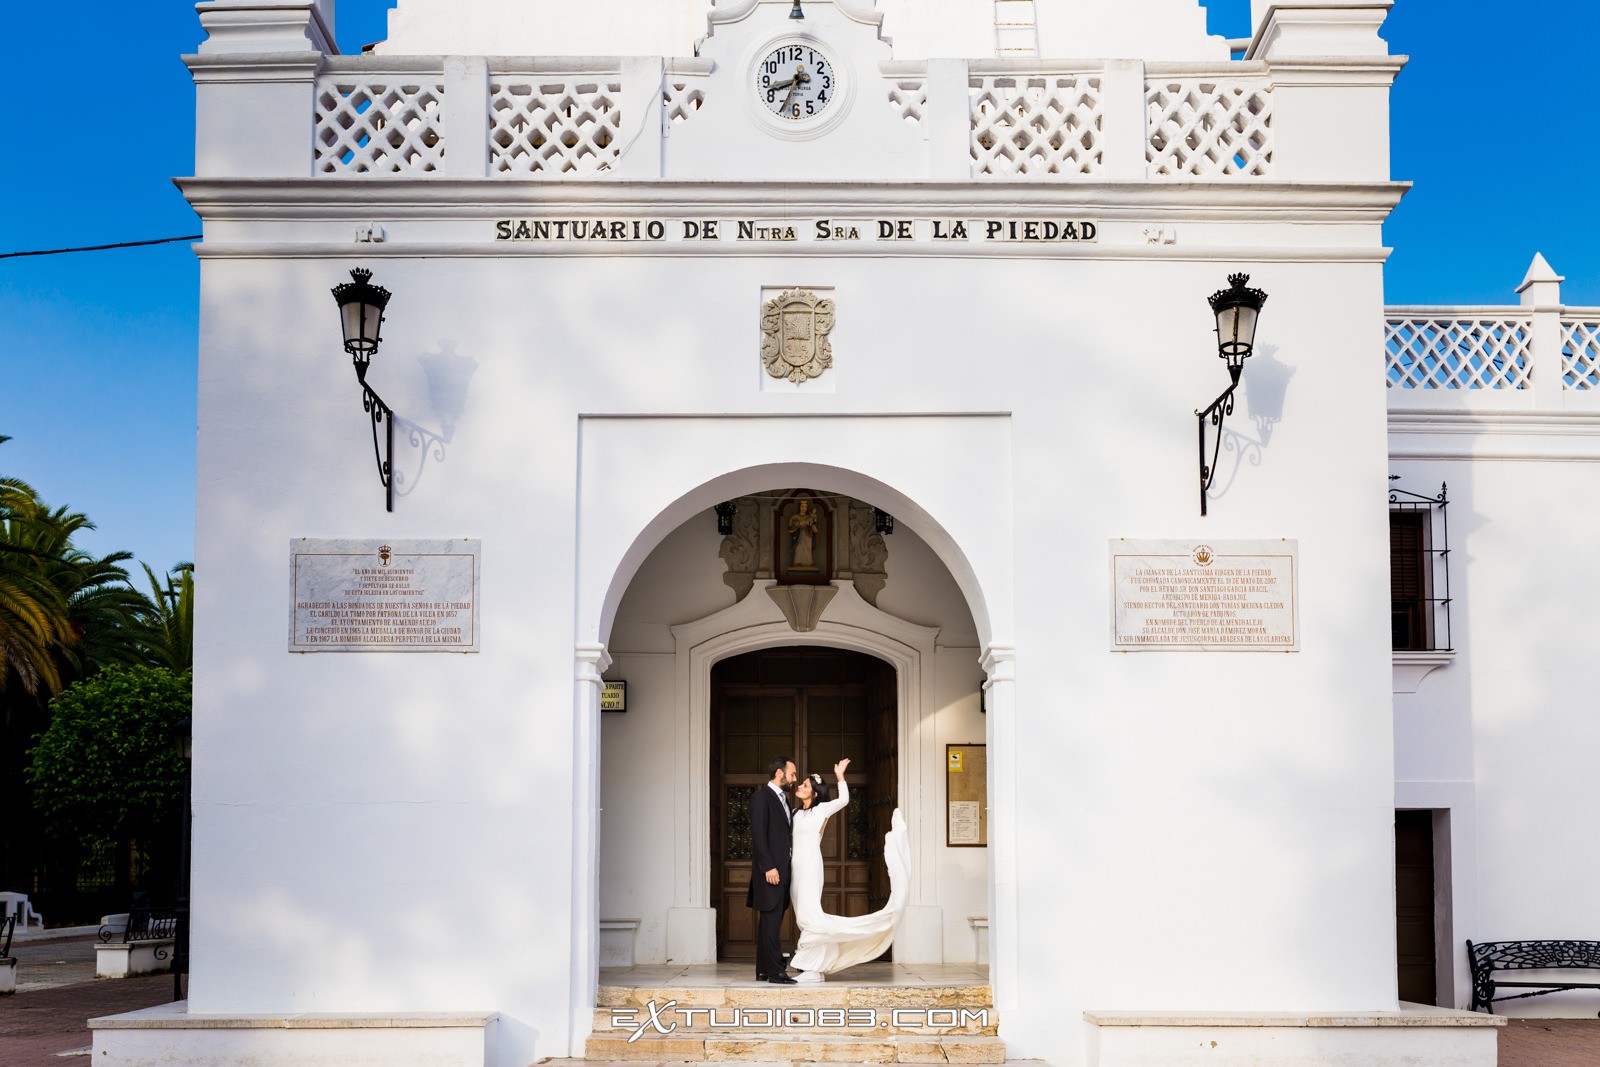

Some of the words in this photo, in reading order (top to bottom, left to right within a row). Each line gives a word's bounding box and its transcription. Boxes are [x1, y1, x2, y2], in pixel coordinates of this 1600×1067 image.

[777, 52, 785, 64] 11
[790, 48, 802, 60] 12
[809, 52, 813, 64] 1
[766, 61, 777, 74] 10
[816, 61, 824, 74] 2
[762, 76, 770, 88] 9
[822, 76, 830, 89] 3
[767, 89, 775, 103] 8
[817, 90, 827, 103] 4
[792, 103, 800, 117] 6
[806, 100, 814, 114] 5
[496, 220, 665, 239] SANTUARIO
[684, 220, 719, 239] DE
[878, 220, 913, 239] DE
[933, 220, 968, 239] LA
[986, 220, 1096, 239] PIEDAD
